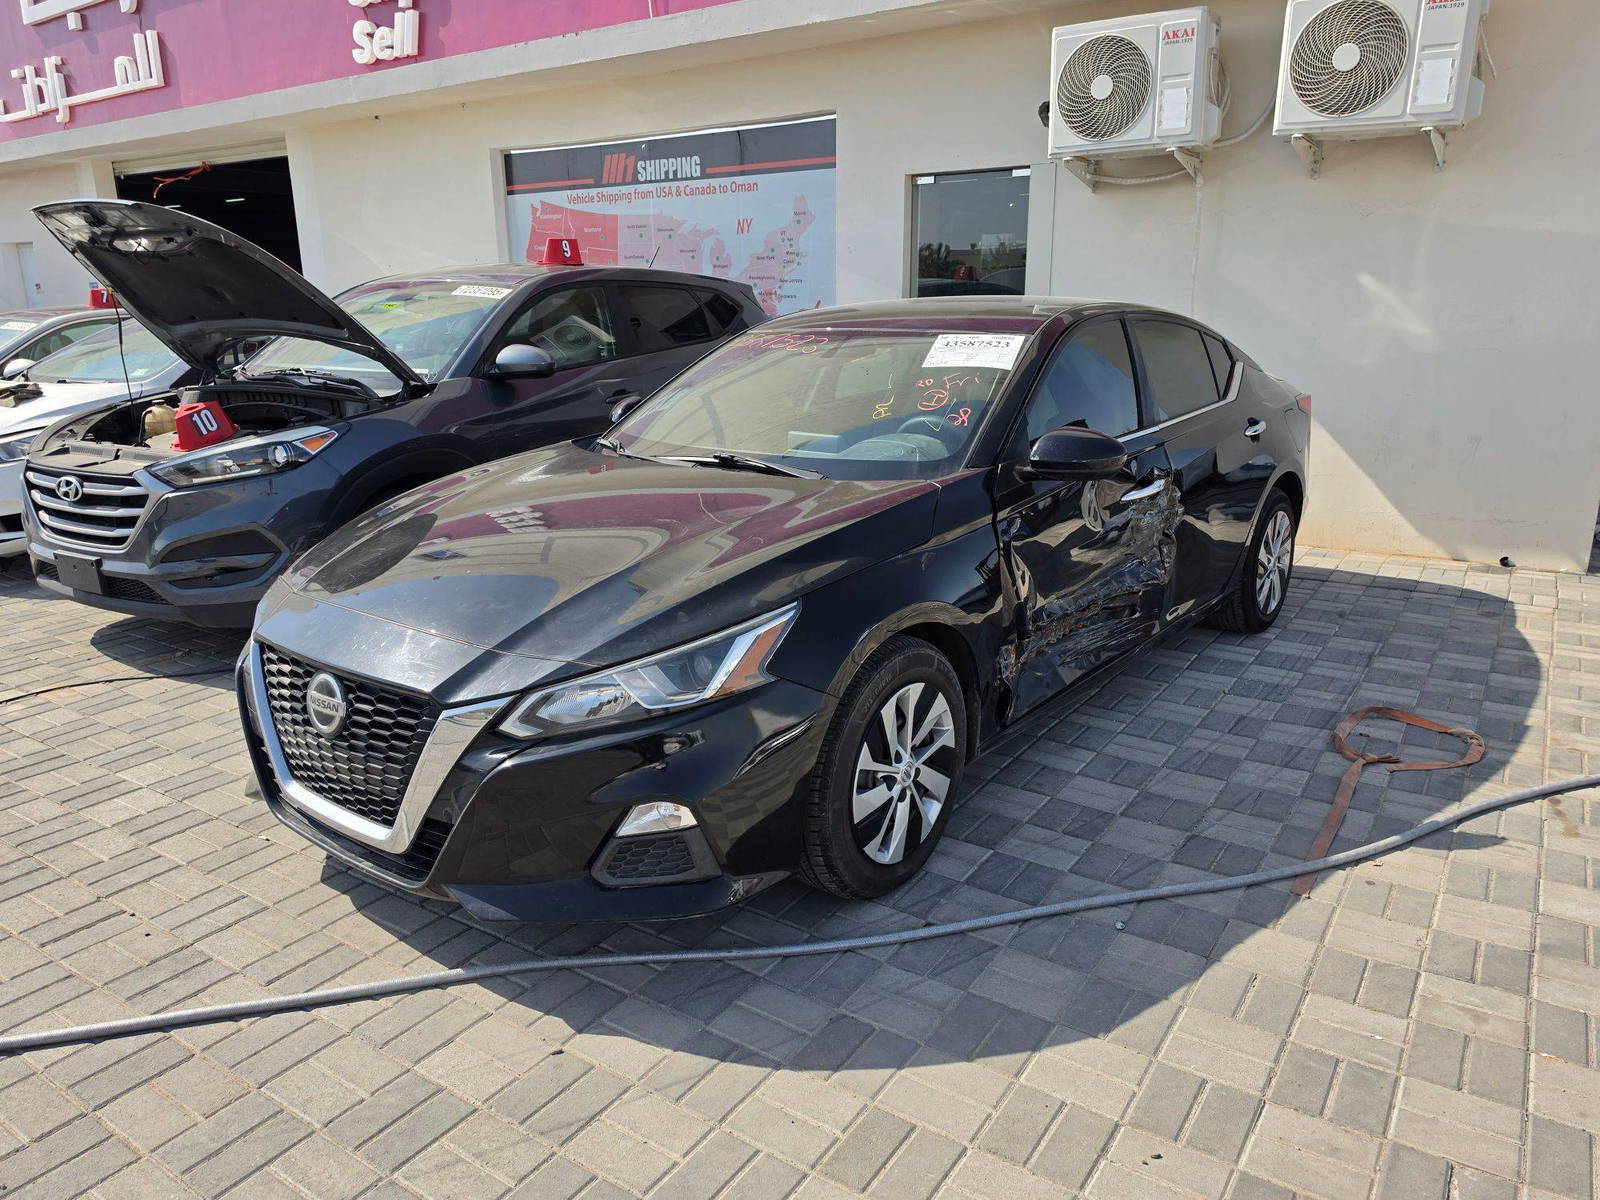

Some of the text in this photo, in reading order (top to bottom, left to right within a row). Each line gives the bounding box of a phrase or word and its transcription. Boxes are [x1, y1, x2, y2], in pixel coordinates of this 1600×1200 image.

[352, 9, 419, 65] Sell
[1163, 27, 1196, 40] AKAI
[637, 155, 701, 182] SHIPPING
[567, 180, 759, 205] Vehicle Shipping from USA & Canada to Oman
[736, 218, 753, 234] NY
[561, 240, 572, 258] 9
[101, 288, 107, 304] 7
[943, 371, 981, 389] Fri
[192, 409, 218, 435] 10
[310, 694, 339, 713] NISSAN
